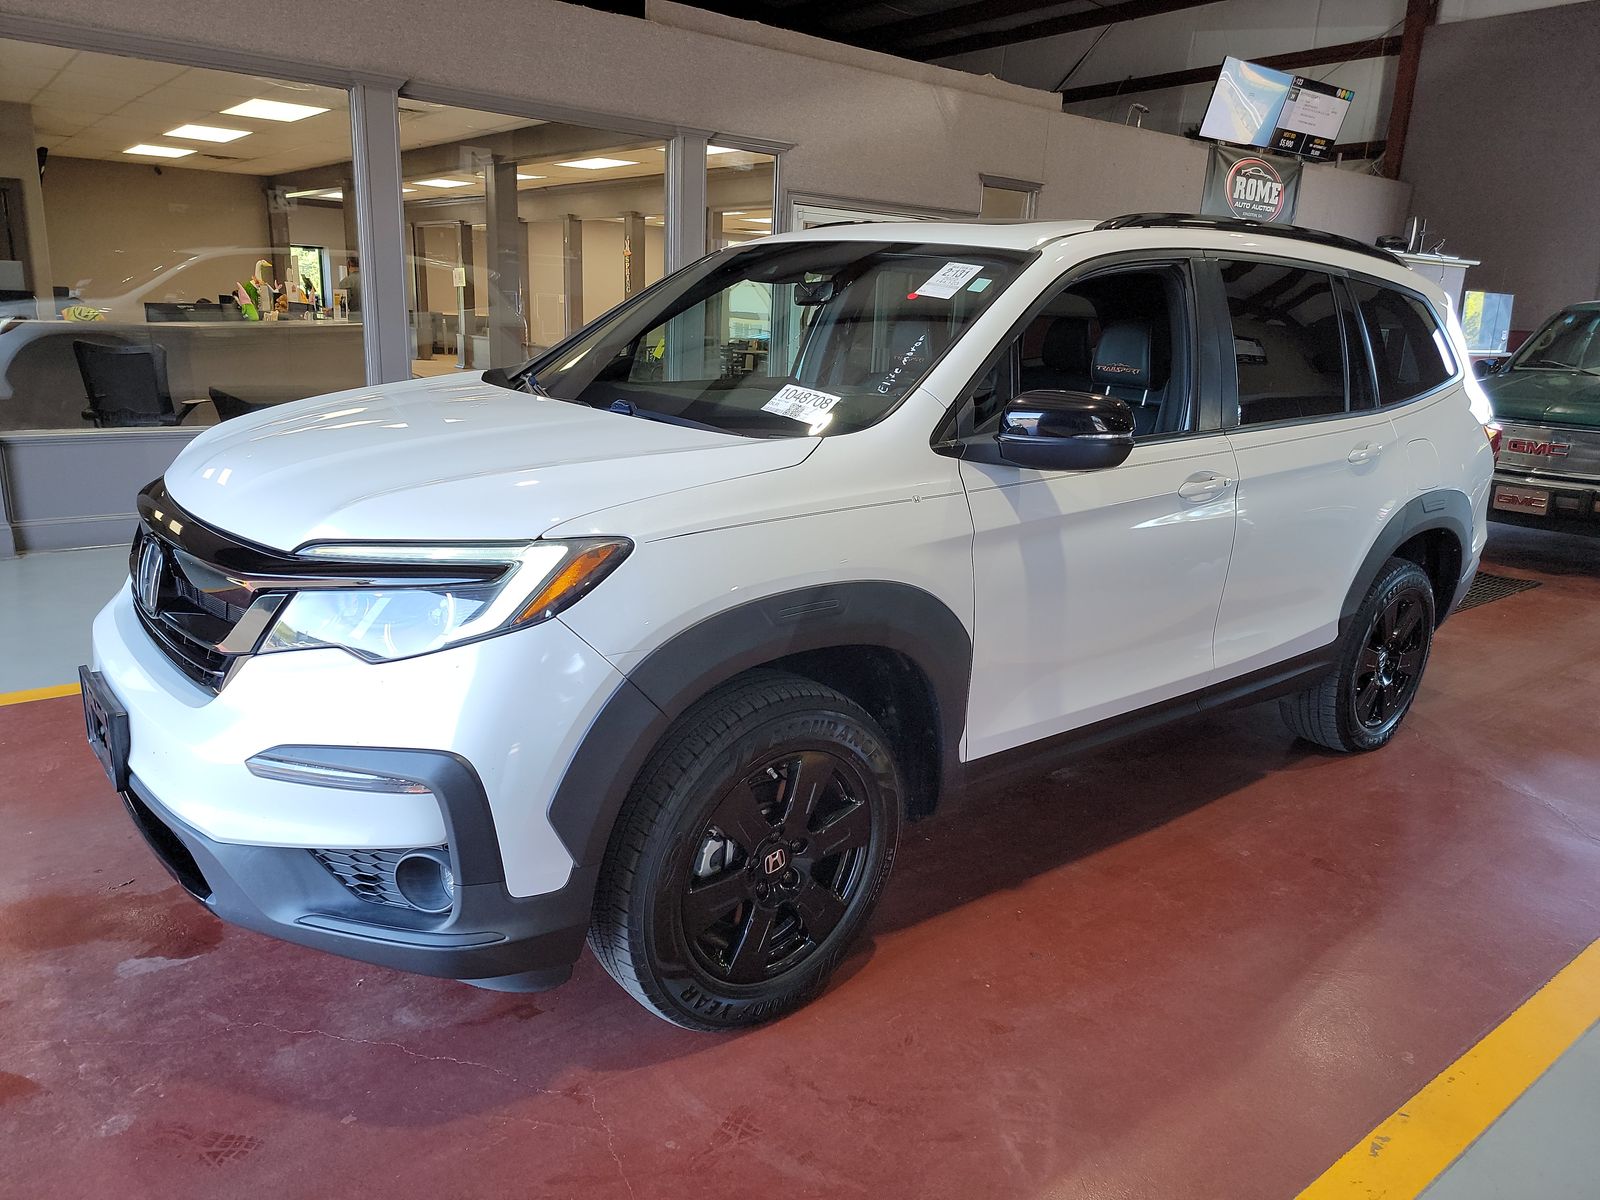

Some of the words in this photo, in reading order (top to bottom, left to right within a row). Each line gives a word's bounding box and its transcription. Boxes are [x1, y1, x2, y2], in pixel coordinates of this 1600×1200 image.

[1233, 176, 1281, 205] ROME
[1234, 201, 1251, 209] AUTO
[1251, 203, 1275, 213] AUCTION
[780, 387, 833, 410] 1048708
[1507, 438, 1570, 457] GMC
[1497, 494, 1546, 508] GMC
[679, 984, 734, 1020] YEAR
